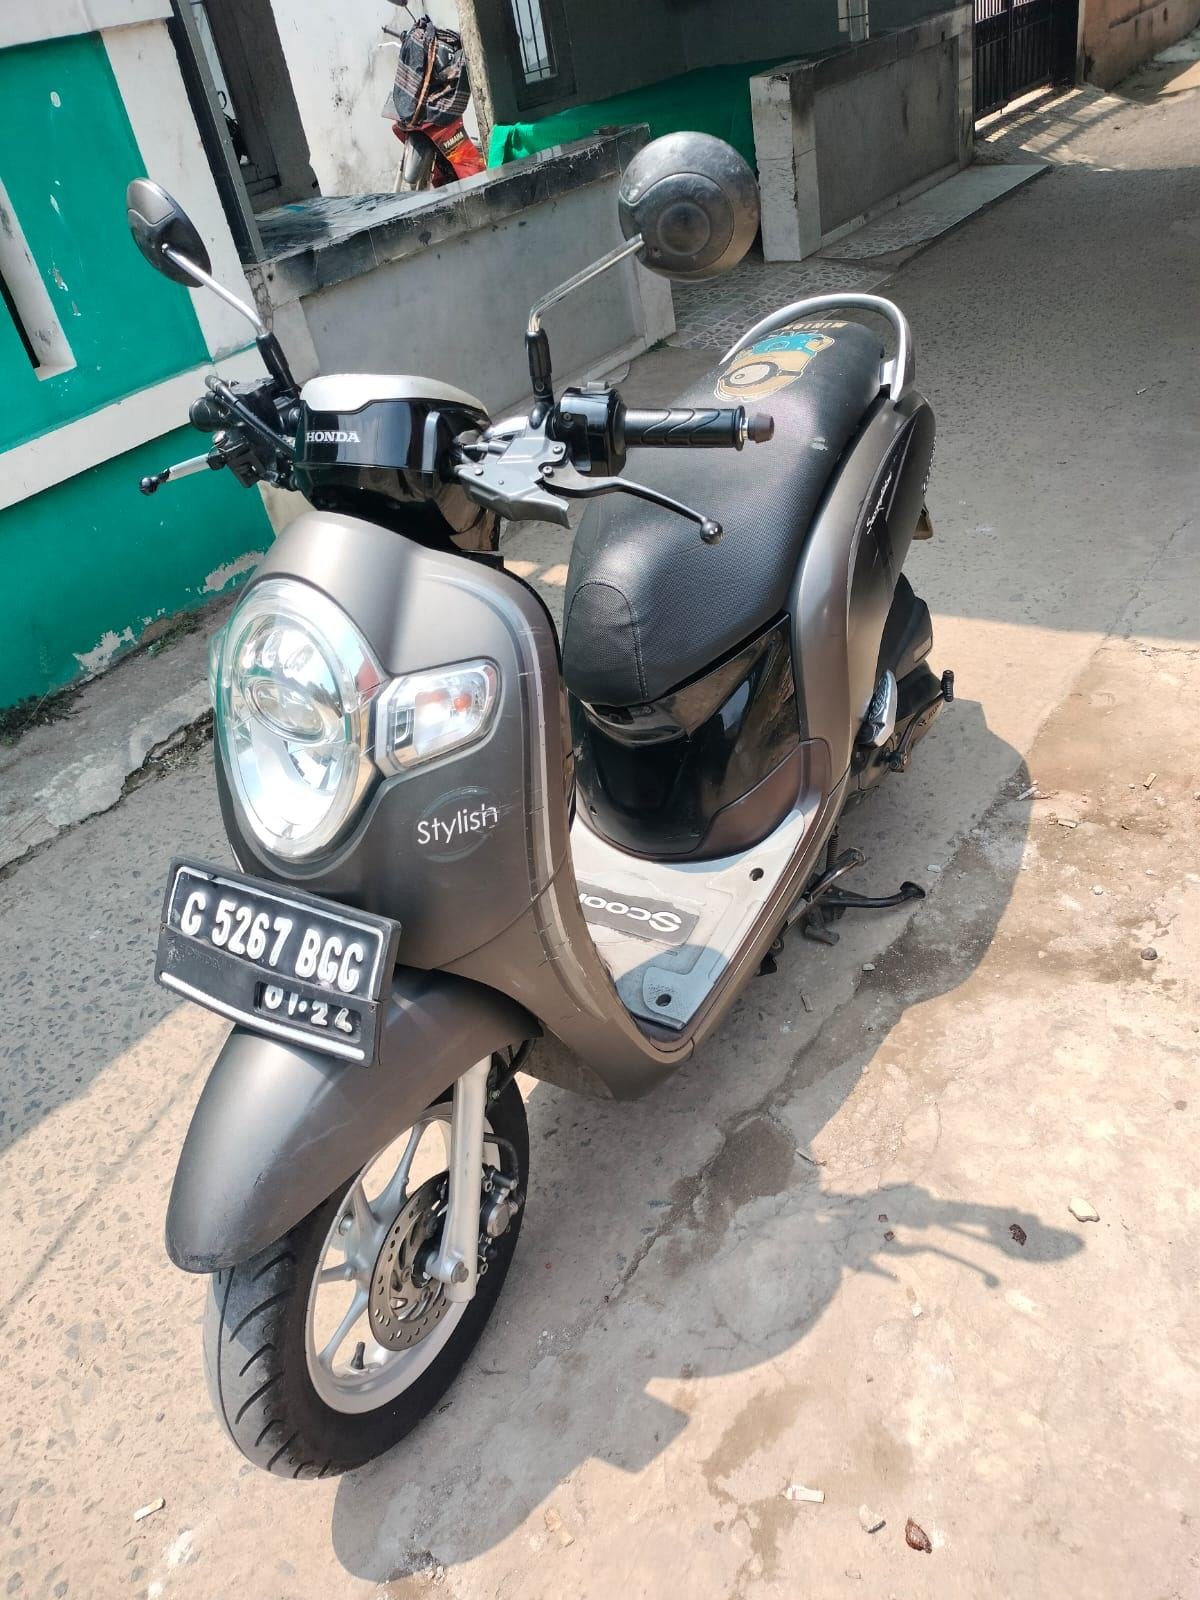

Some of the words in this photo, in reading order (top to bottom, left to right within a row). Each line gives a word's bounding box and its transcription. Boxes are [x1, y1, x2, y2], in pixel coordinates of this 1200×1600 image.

[443, 131, 464, 149] YAMAHA
[305, 431, 361, 443] HONDA
[416, 803, 498, 845] Stylish
[211, 899, 293, 967] 5267
